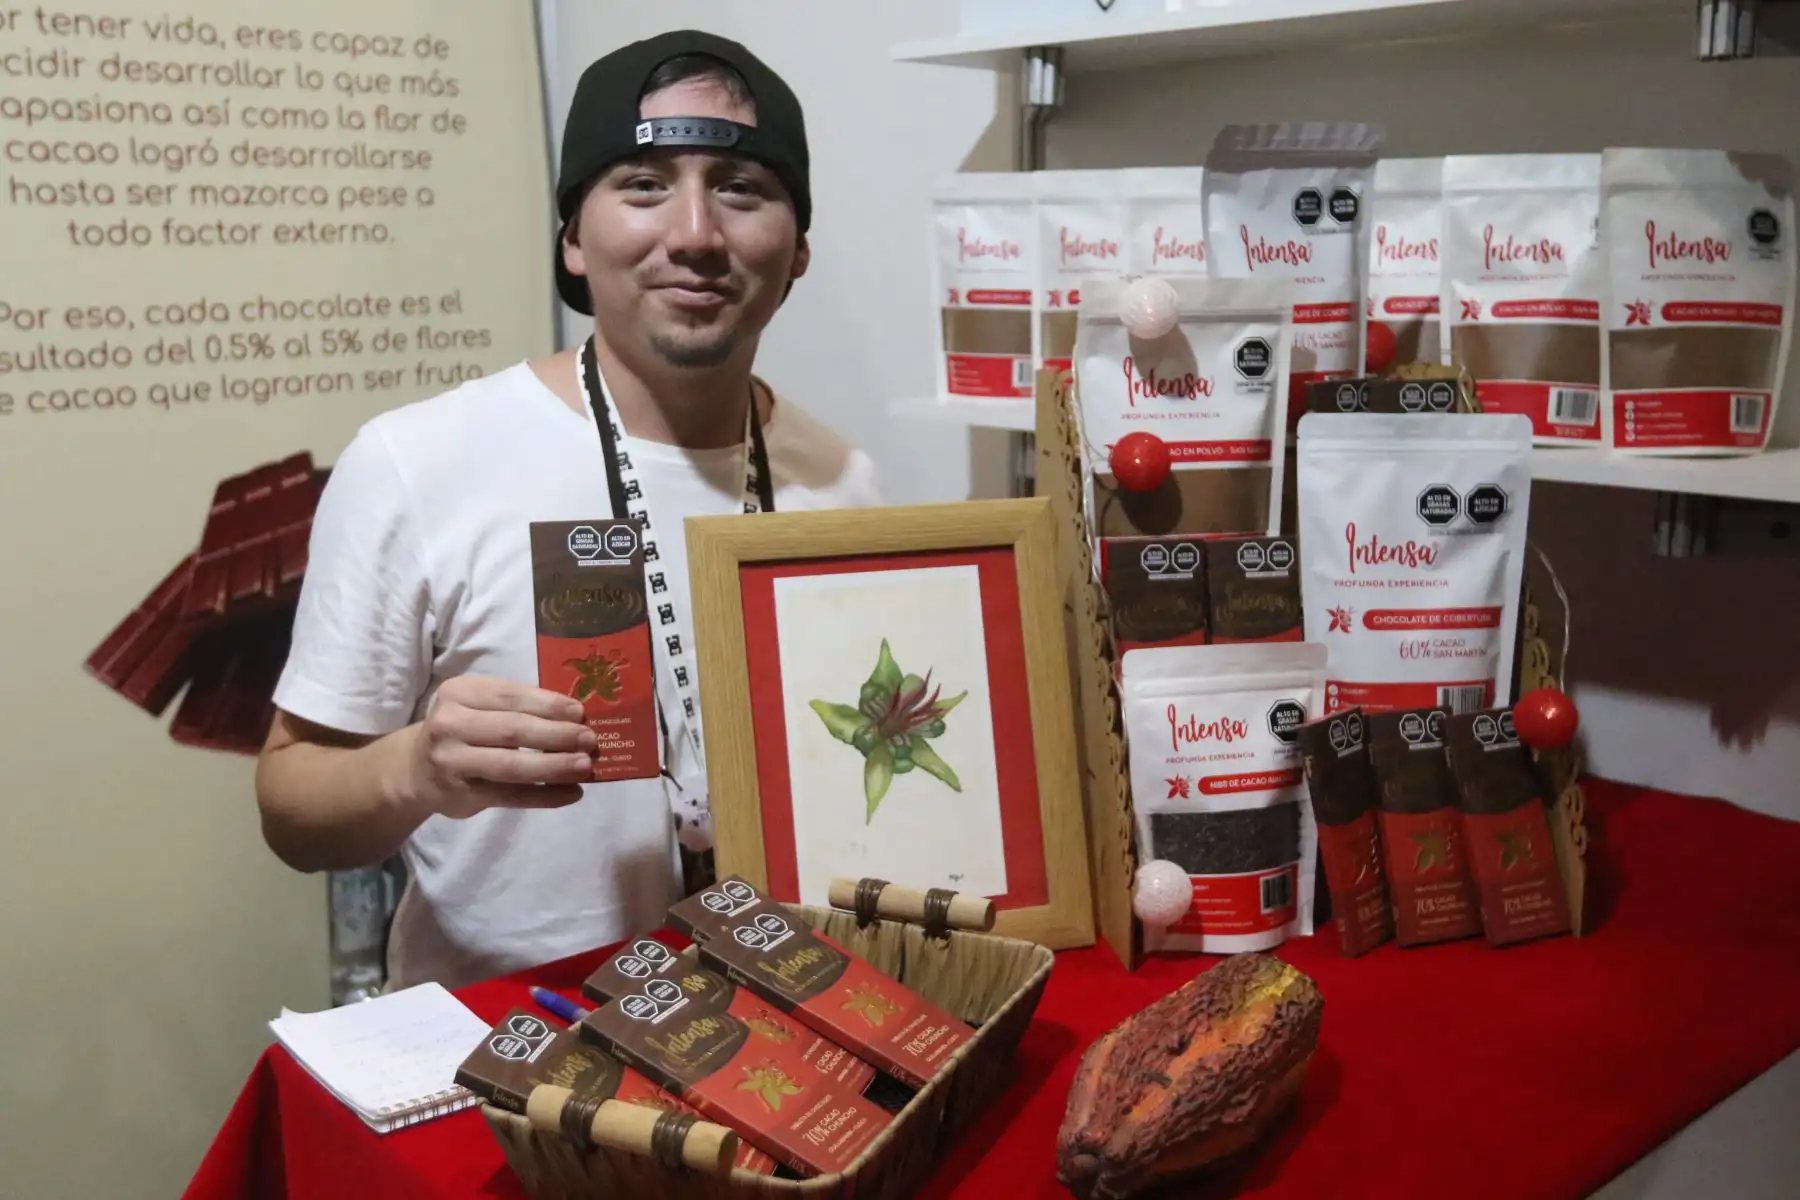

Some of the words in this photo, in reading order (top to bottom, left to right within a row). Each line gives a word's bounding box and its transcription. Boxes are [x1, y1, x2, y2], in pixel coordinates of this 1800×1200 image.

[36, 5, 132, 39] tener
[144, 13, 226, 50] vida,
[236, 23, 302, 51] eres
[312, 29, 405, 60] capaz
[413, 32, 450, 60] de
[0, 47, 86, 79] cidir
[99, 52, 286, 89] desarrollar
[295, 64, 324, 92] lo
[334, 70, 391, 101] que
[400, 69, 460, 98] más
[0, 93, 172, 127] apasiona
[183, 97, 231, 127] así
[241, 105, 329, 130] como
[337, 104, 366, 131] la
[374, 105, 422, 133] flor
[431, 108, 467, 135] de
[6, 139, 119, 164] cacao
[129, 135, 219, 172] logró
[230, 138, 432, 171] desarrollarse
[9, 174, 115, 207] hasta
[127, 182, 178, 206] ser
[190, 183, 329, 207] mazorca
[339, 184, 408, 211] pese
[417, 187, 435, 207] a
[67, 218, 152, 247] todo
[162, 217, 260, 246] factor
[273, 220, 395, 245] externo.
[1060, 226, 1119, 264] Intensa
[1153, 226, 1206, 265] Intens
[1240, 224, 1312, 271] Intensa
[1377, 225, 1438, 268] Intens
[1484, 223, 1564, 270] Intensa
[1645, 219, 1732, 269] Intensa
[64, 305, 135, 331] eso,
[146, 297, 230, 325] cada
[240, 293, 391, 322] chocolate
[400, 294, 430, 316] es
[440, 288, 463, 314] el
[145, 336, 195, 366] del
[204, 332, 275, 362] 0.5%
[284, 333, 311, 358] al
[321, 329, 363, 355] 5%
[372, 328, 408, 353] de
[417, 325, 491, 350] flores
[28, 386, 136, 413] cacao
[149, 381, 211, 412] que
[221, 371, 353, 404] lograron
[364, 368, 403, 391] ser
[1123, 356, 1213, 407] Intensa
[1345, 521, 1437, 573] Intensa
[1334, 579, 1384, 588] PROFUNDA
[1388, 579, 1448, 588] EXPERIENCIA
[1373, 615, 1426, 625] CHOCOLATE
[1429, 614, 1441, 624] DE
[1400, 639, 1431, 659] 60%
[1433, 639, 1465, 648] CACAO
[1433, 649, 1452, 658] SAN
[597, 732, 620, 740] ACAO
[598, 740, 635, 749] HUNCHO
[1167, 704, 1248, 751] Intensa
[1240, 778, 1267, 786] CACAO
[801, 1122, 830, 1147] 70%
[819, 1108, 841, 1126] CACAO
[828, 1106, 857, 1132] CHUNCHO
